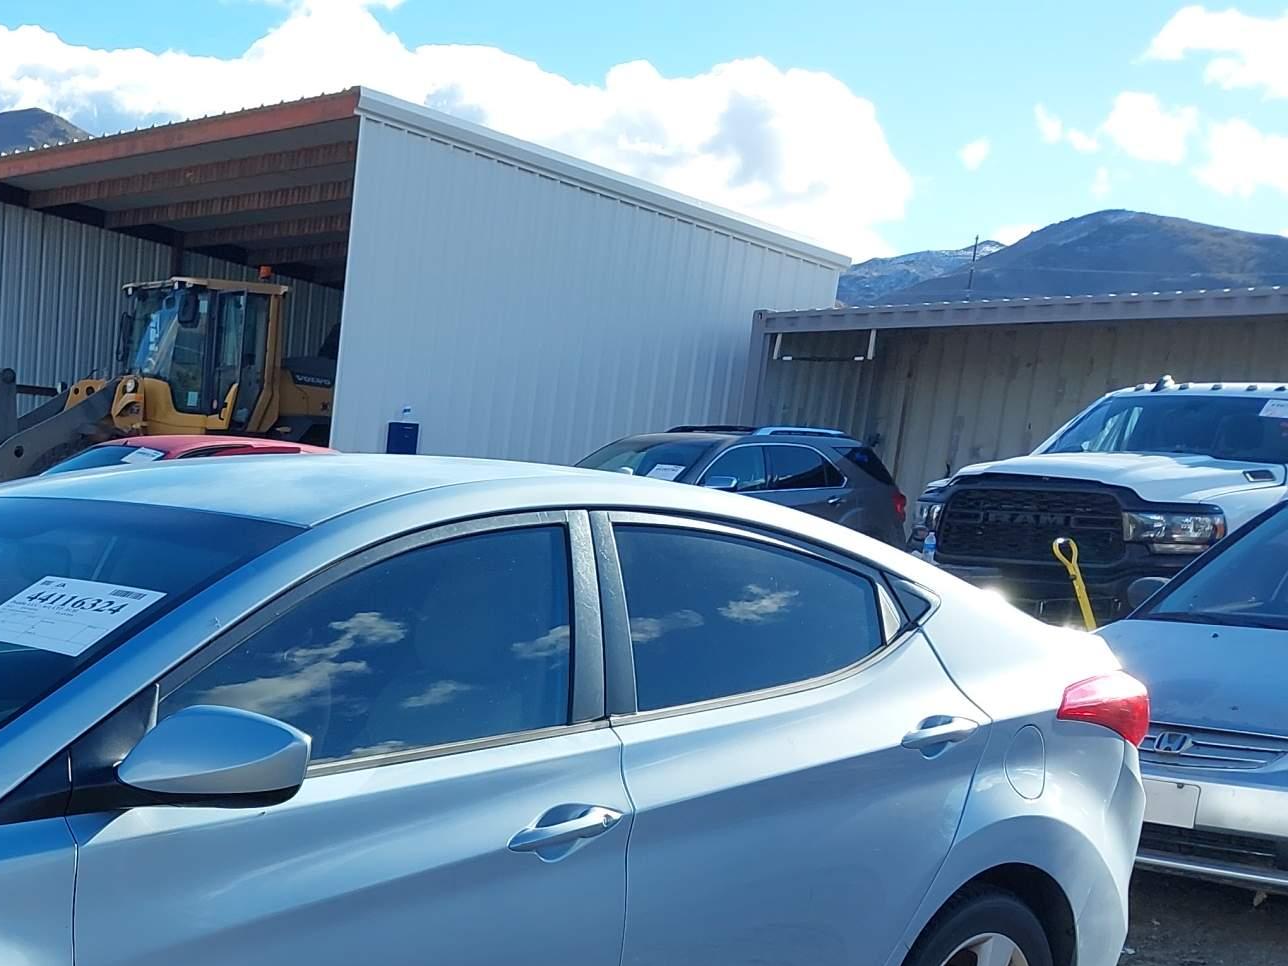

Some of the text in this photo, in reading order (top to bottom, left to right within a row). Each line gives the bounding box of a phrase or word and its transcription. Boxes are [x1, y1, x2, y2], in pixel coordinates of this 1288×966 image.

[295, 374, 331, 385] VOLVO
[987, 510, 1066, 526] RAM
[26, 590, 129, 615] 44116324
